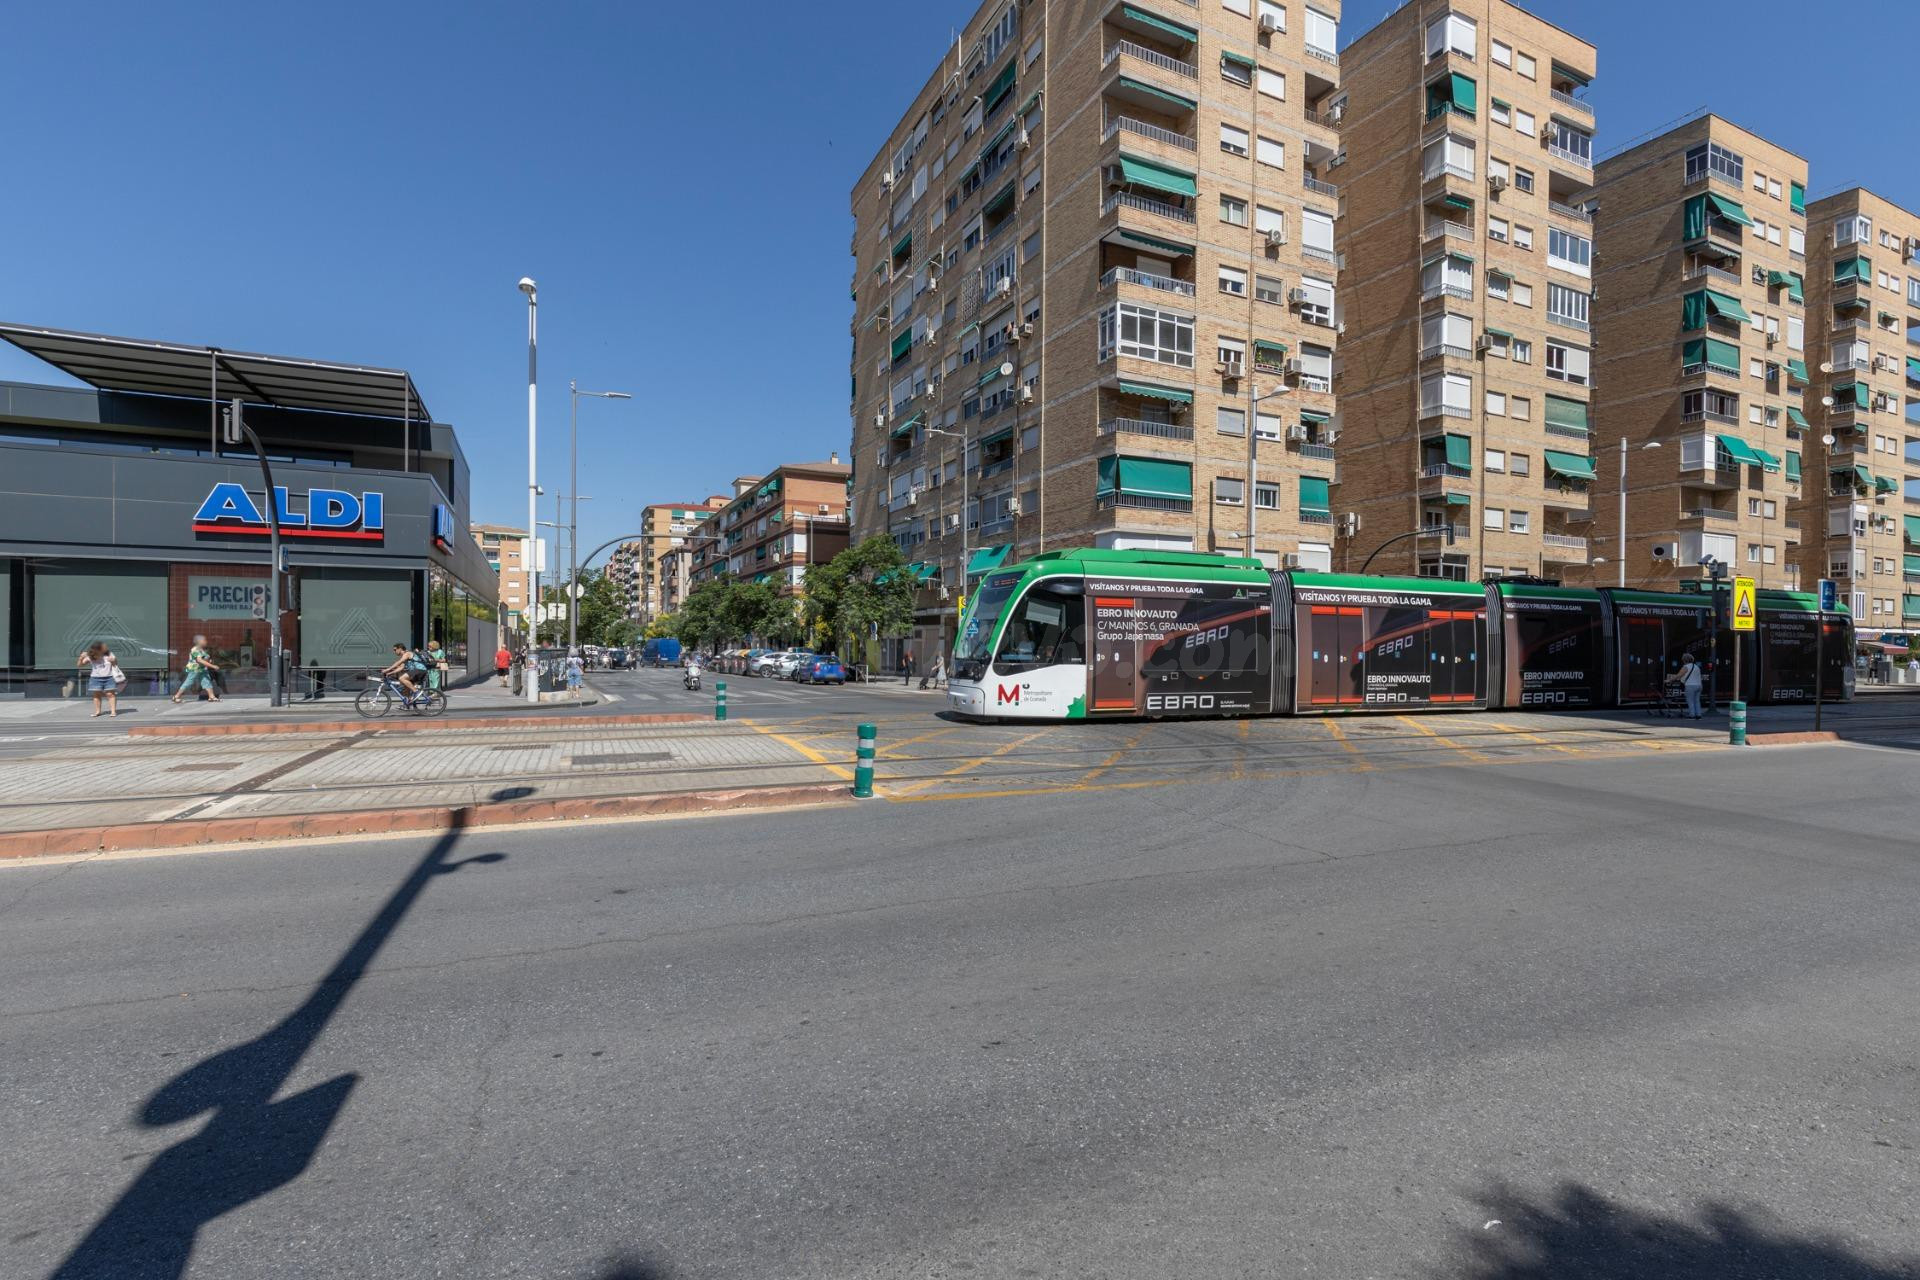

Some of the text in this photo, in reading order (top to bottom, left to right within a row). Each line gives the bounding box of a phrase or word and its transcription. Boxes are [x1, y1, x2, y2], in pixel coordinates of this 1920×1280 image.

[193, 483, 383, 529] ALDI
[1089, 583, 1124, 591] VISÍTANOS
[198, 585, 272, 602] PRECIS
[1299, 591, 1432, 606] VISÍTANOS Y PRUEBA TODA LA GAMA
[1097, 609, 1178, 618] EBRO INNOVAUTO
[1097, 621, 1107, 630] C/
[1159, 622, 1200, 631] GRANADA
[1097, 631, 1123, 641] Grupo
[1185, 624, 1229, 648] EBRO
[1378, 635, 1414, 656] EBRO
[1367, 675, 1431, 683] EBRO INNOVAUTO
[1524, 671, 1583, 680] EBRO INNOVAUTO
[1366, 693, 1407, 703] EBRO
[1522, 692, 1565, 704] EBRO
[1773, 689, 1804, 699] EBRO
[1147, 695, 1214, 709] EBRO
